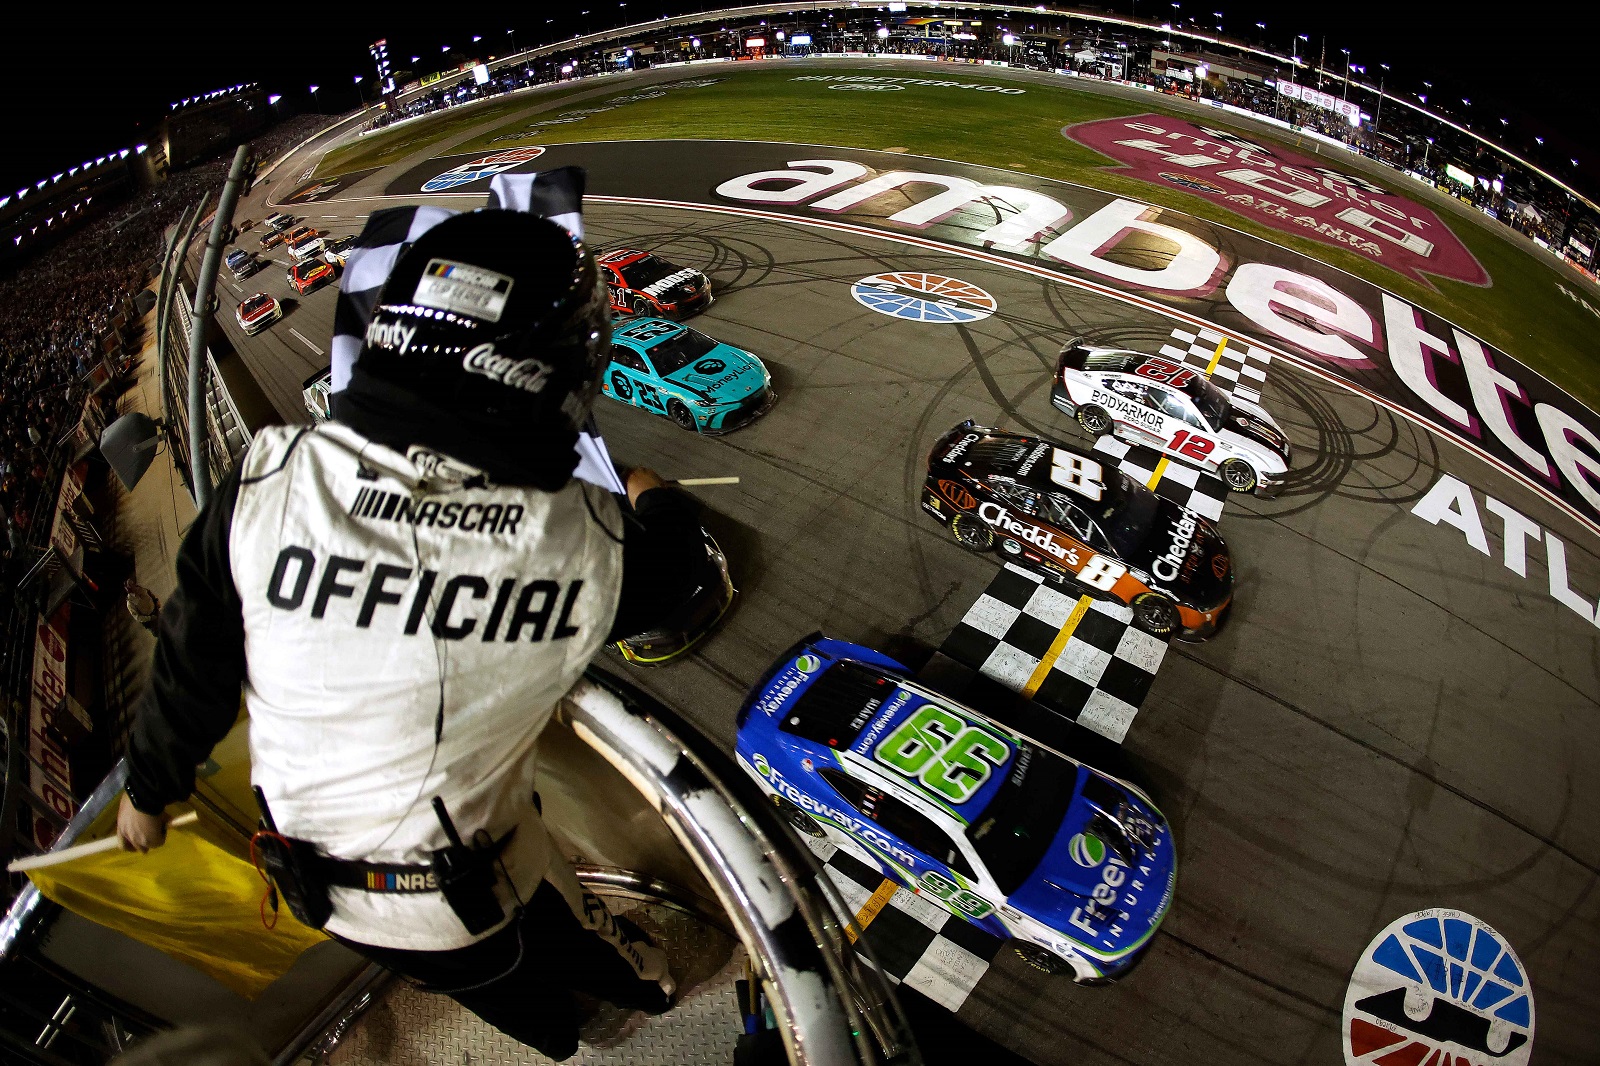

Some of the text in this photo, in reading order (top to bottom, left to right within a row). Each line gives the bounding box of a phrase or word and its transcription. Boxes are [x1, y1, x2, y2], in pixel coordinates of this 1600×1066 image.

[1113, 139, 1435, 258] 400
[1124, 122, 1431, 229] ambetter
[1225, 194, 1382, 254] ATLANTA
[367, 317, 417, 355] finity
[634, 379, 668, 412] 23
[703, 361, 759, 398] MoneyLion
[1135, 358, 1197, 388] 12
[1091, 389, 1164, 430] BODYARMOR
[1141, 420, 1161, 434] SUGAR
[942, 431, 980, 464] Cheddar's
[1167, 429, 1216, 462] 12
[1050, 447, 1103, 502] 8
[394, 497, 525, 535] NASCAR
[978, 501, 1080, 568] Cheddar's
[1075, 553, 1127, 592] 8
[1410, 477, 1600, 630] ATL
[266, 545, 584, 643] OFFICIAL
[762, 670, 810, 718] Freeway
[855, 697, 907, 755] Freeway.com
[769, 765, 916, 867] Freeway.com
[914, 869, 998, 920] 99
